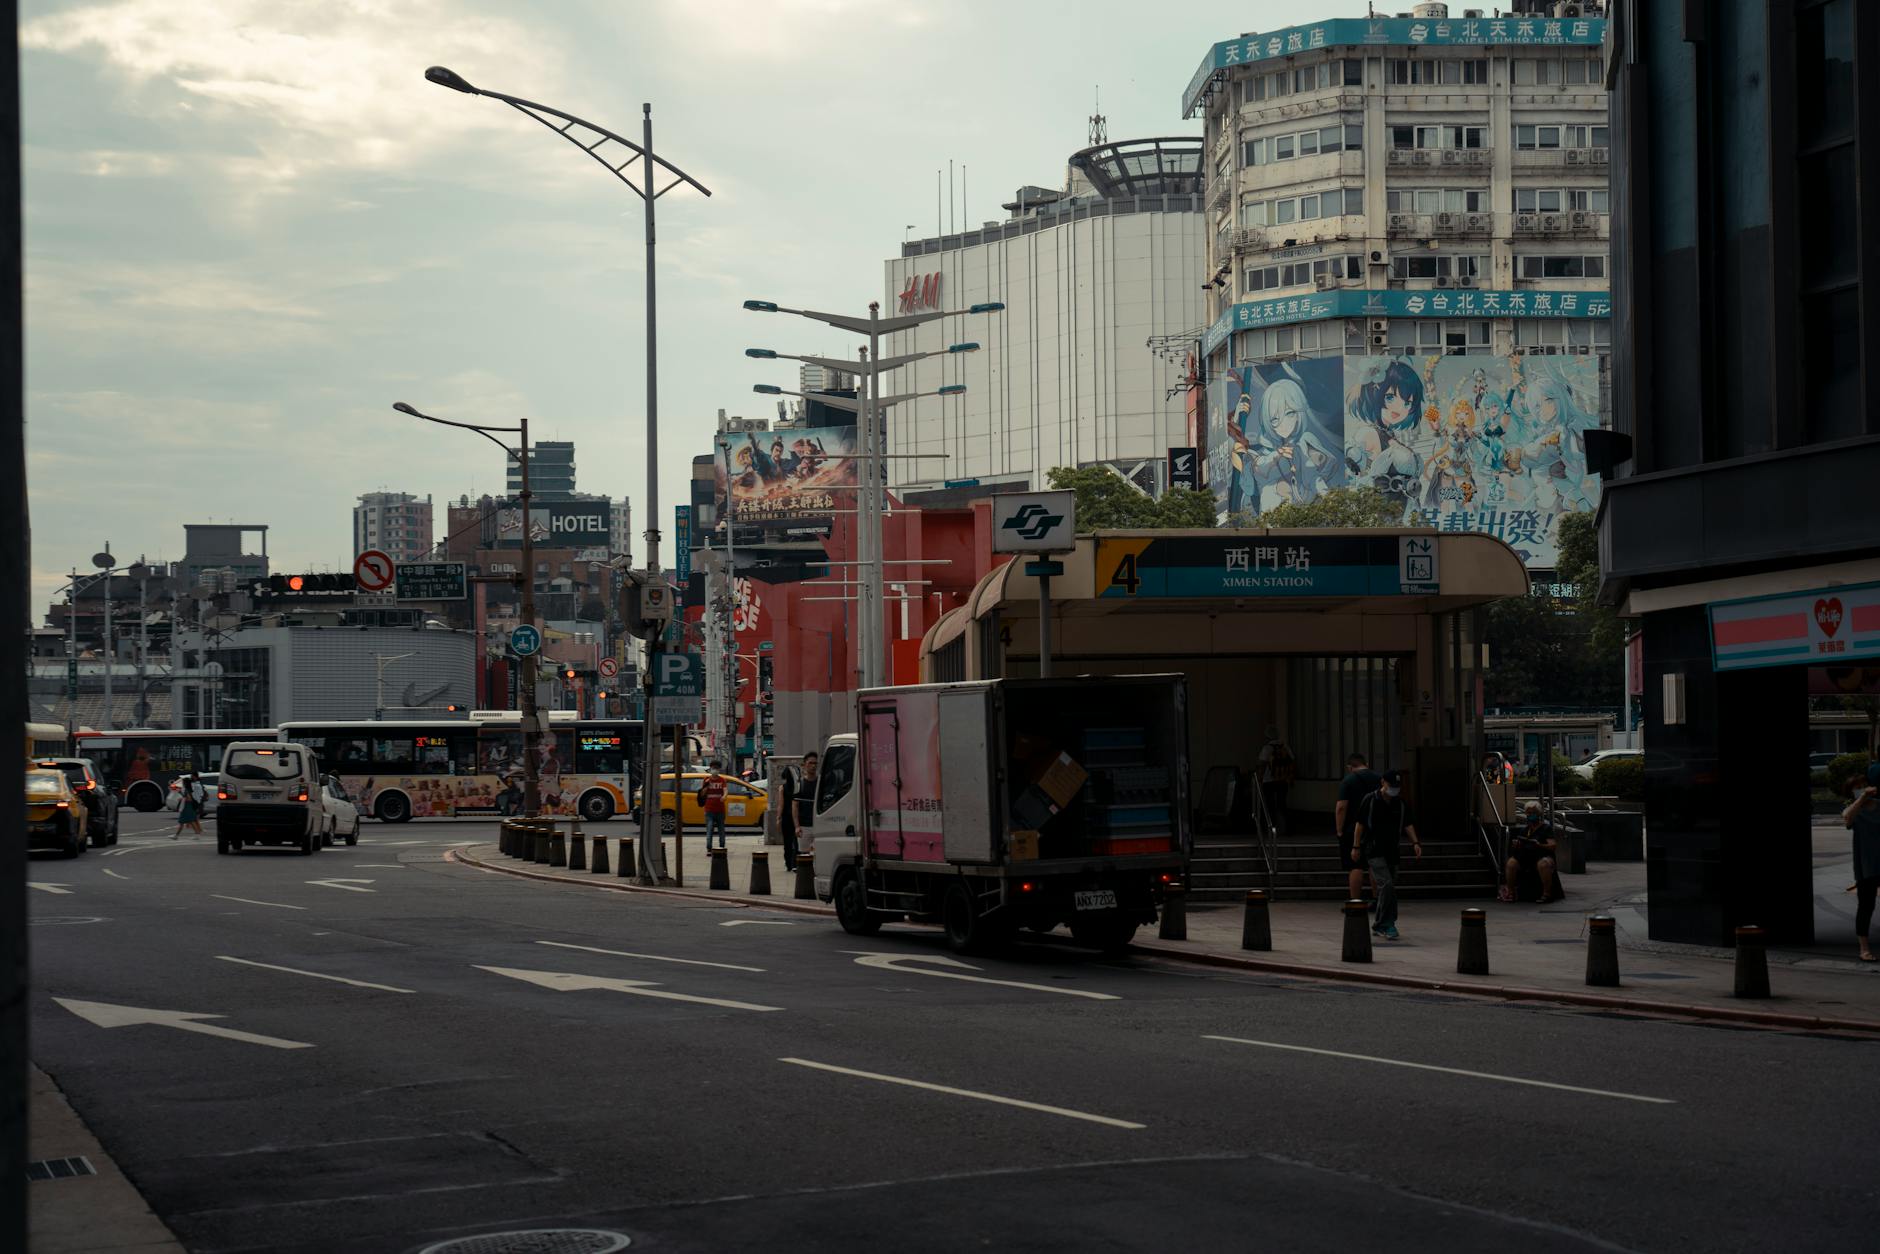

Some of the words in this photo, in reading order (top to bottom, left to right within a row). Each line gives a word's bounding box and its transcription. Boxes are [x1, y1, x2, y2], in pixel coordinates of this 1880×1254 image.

[1435, 21, 1589, 37] 台北天禾旅店
[899, 272, 941, 313] H&M
[1432, 293, 1577, 310] 台北天禾旅店
[1239, 299, 1311, 321] 台北天禾旅店
[1244, 318, 1265, 326] TAIPEI
[1286, 313, 1306, 321] HOTEL
[552, 515, 608, 533] HOTEL
[679, 540, 689, 580] HOTEL
[1224, 547, 1311, 573] 西門站
[1111, 553, 1141, 595] 4
[1222, 577, 1262, 587] XIMEN
[1263, 577, 1314, 587] STATION
[1000, 625, 1012, 647] 4
[661, 654, 690, 683] P
[676, 685, 696, 695] 40M
